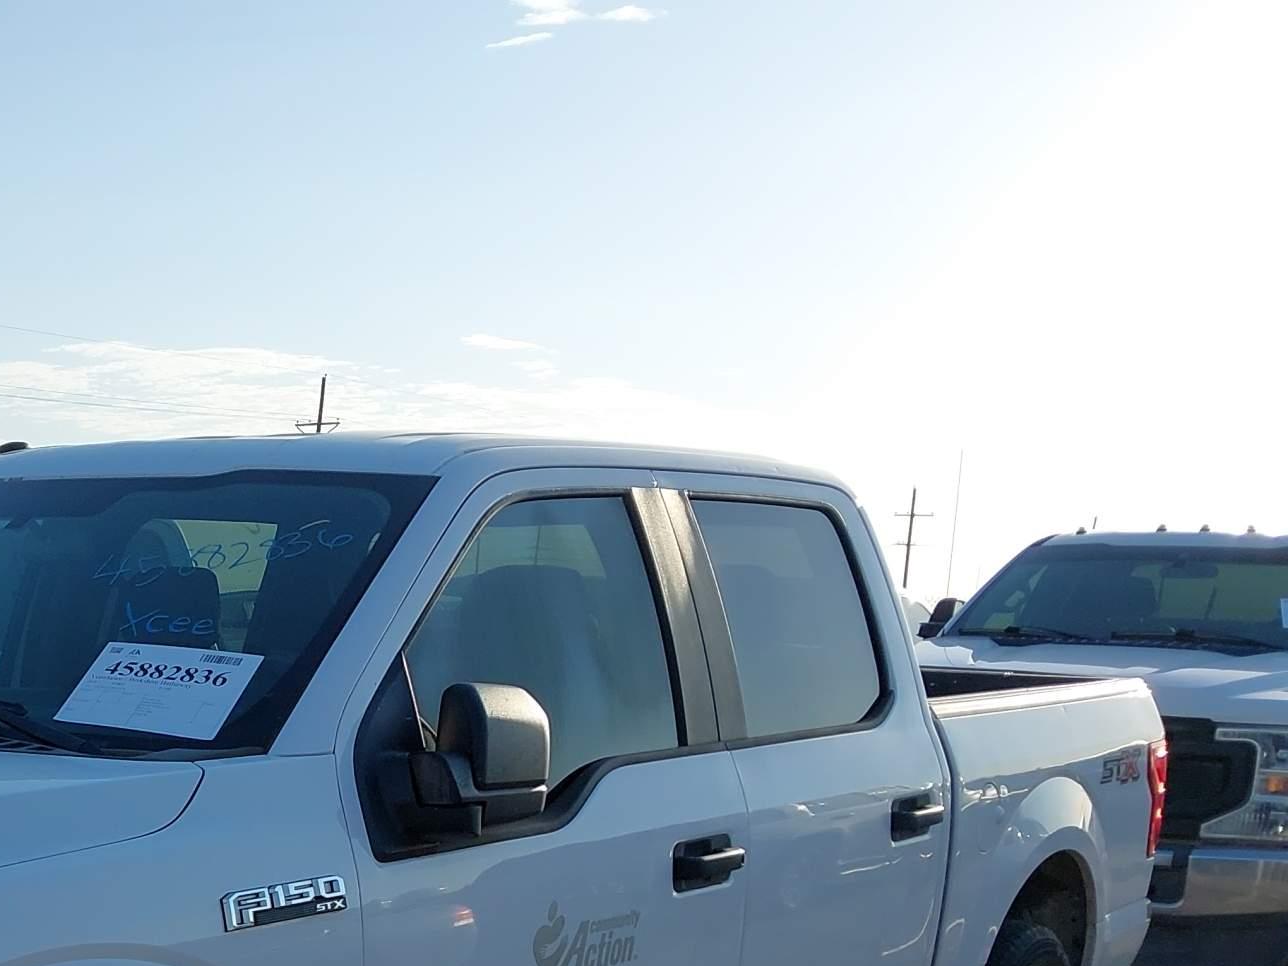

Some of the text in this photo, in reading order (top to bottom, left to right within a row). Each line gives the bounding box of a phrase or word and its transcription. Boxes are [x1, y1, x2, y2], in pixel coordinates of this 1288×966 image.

[105, 660, 232, 687] 45882836
[1100, 749, 1141, 785] STX
[316, 898, 345, 912] STX
